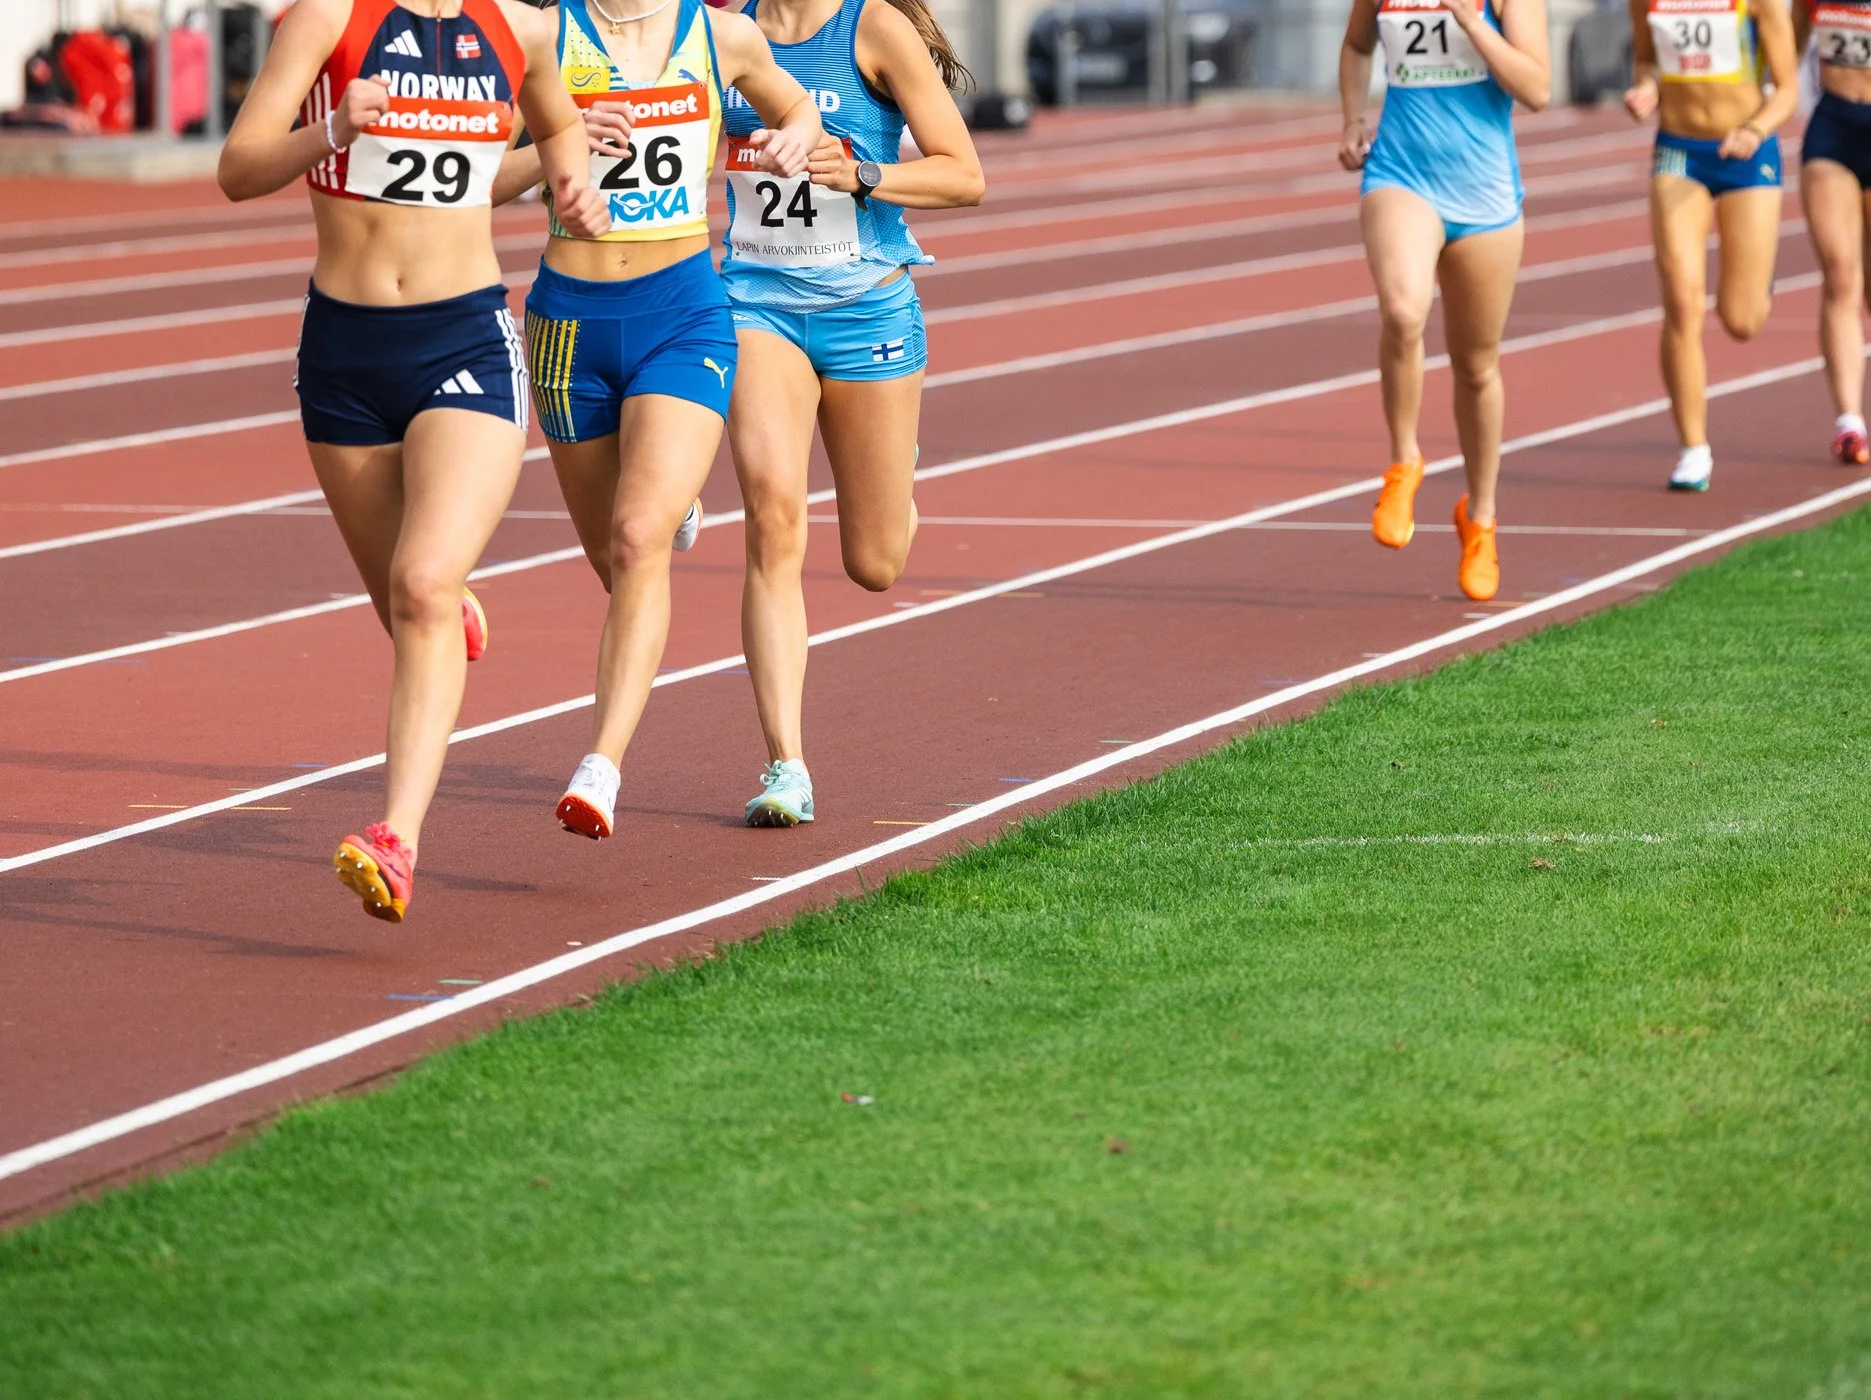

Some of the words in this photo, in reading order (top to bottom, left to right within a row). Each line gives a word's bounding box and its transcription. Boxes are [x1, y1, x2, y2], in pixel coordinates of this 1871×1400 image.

[1405, 20, 1449, 55] 21
[1673, 20, 1711, 50] 30
[381, 69, 496, 103] NORWAY
[381, 149, 471, 203] 29
[598, 135, 683, 190] 26
[755, 180, 818, 227] 24
[736, 241, 760, 254] LAPIN
[762, 241, 854, 256] ARVOKIINTEISTÖT
